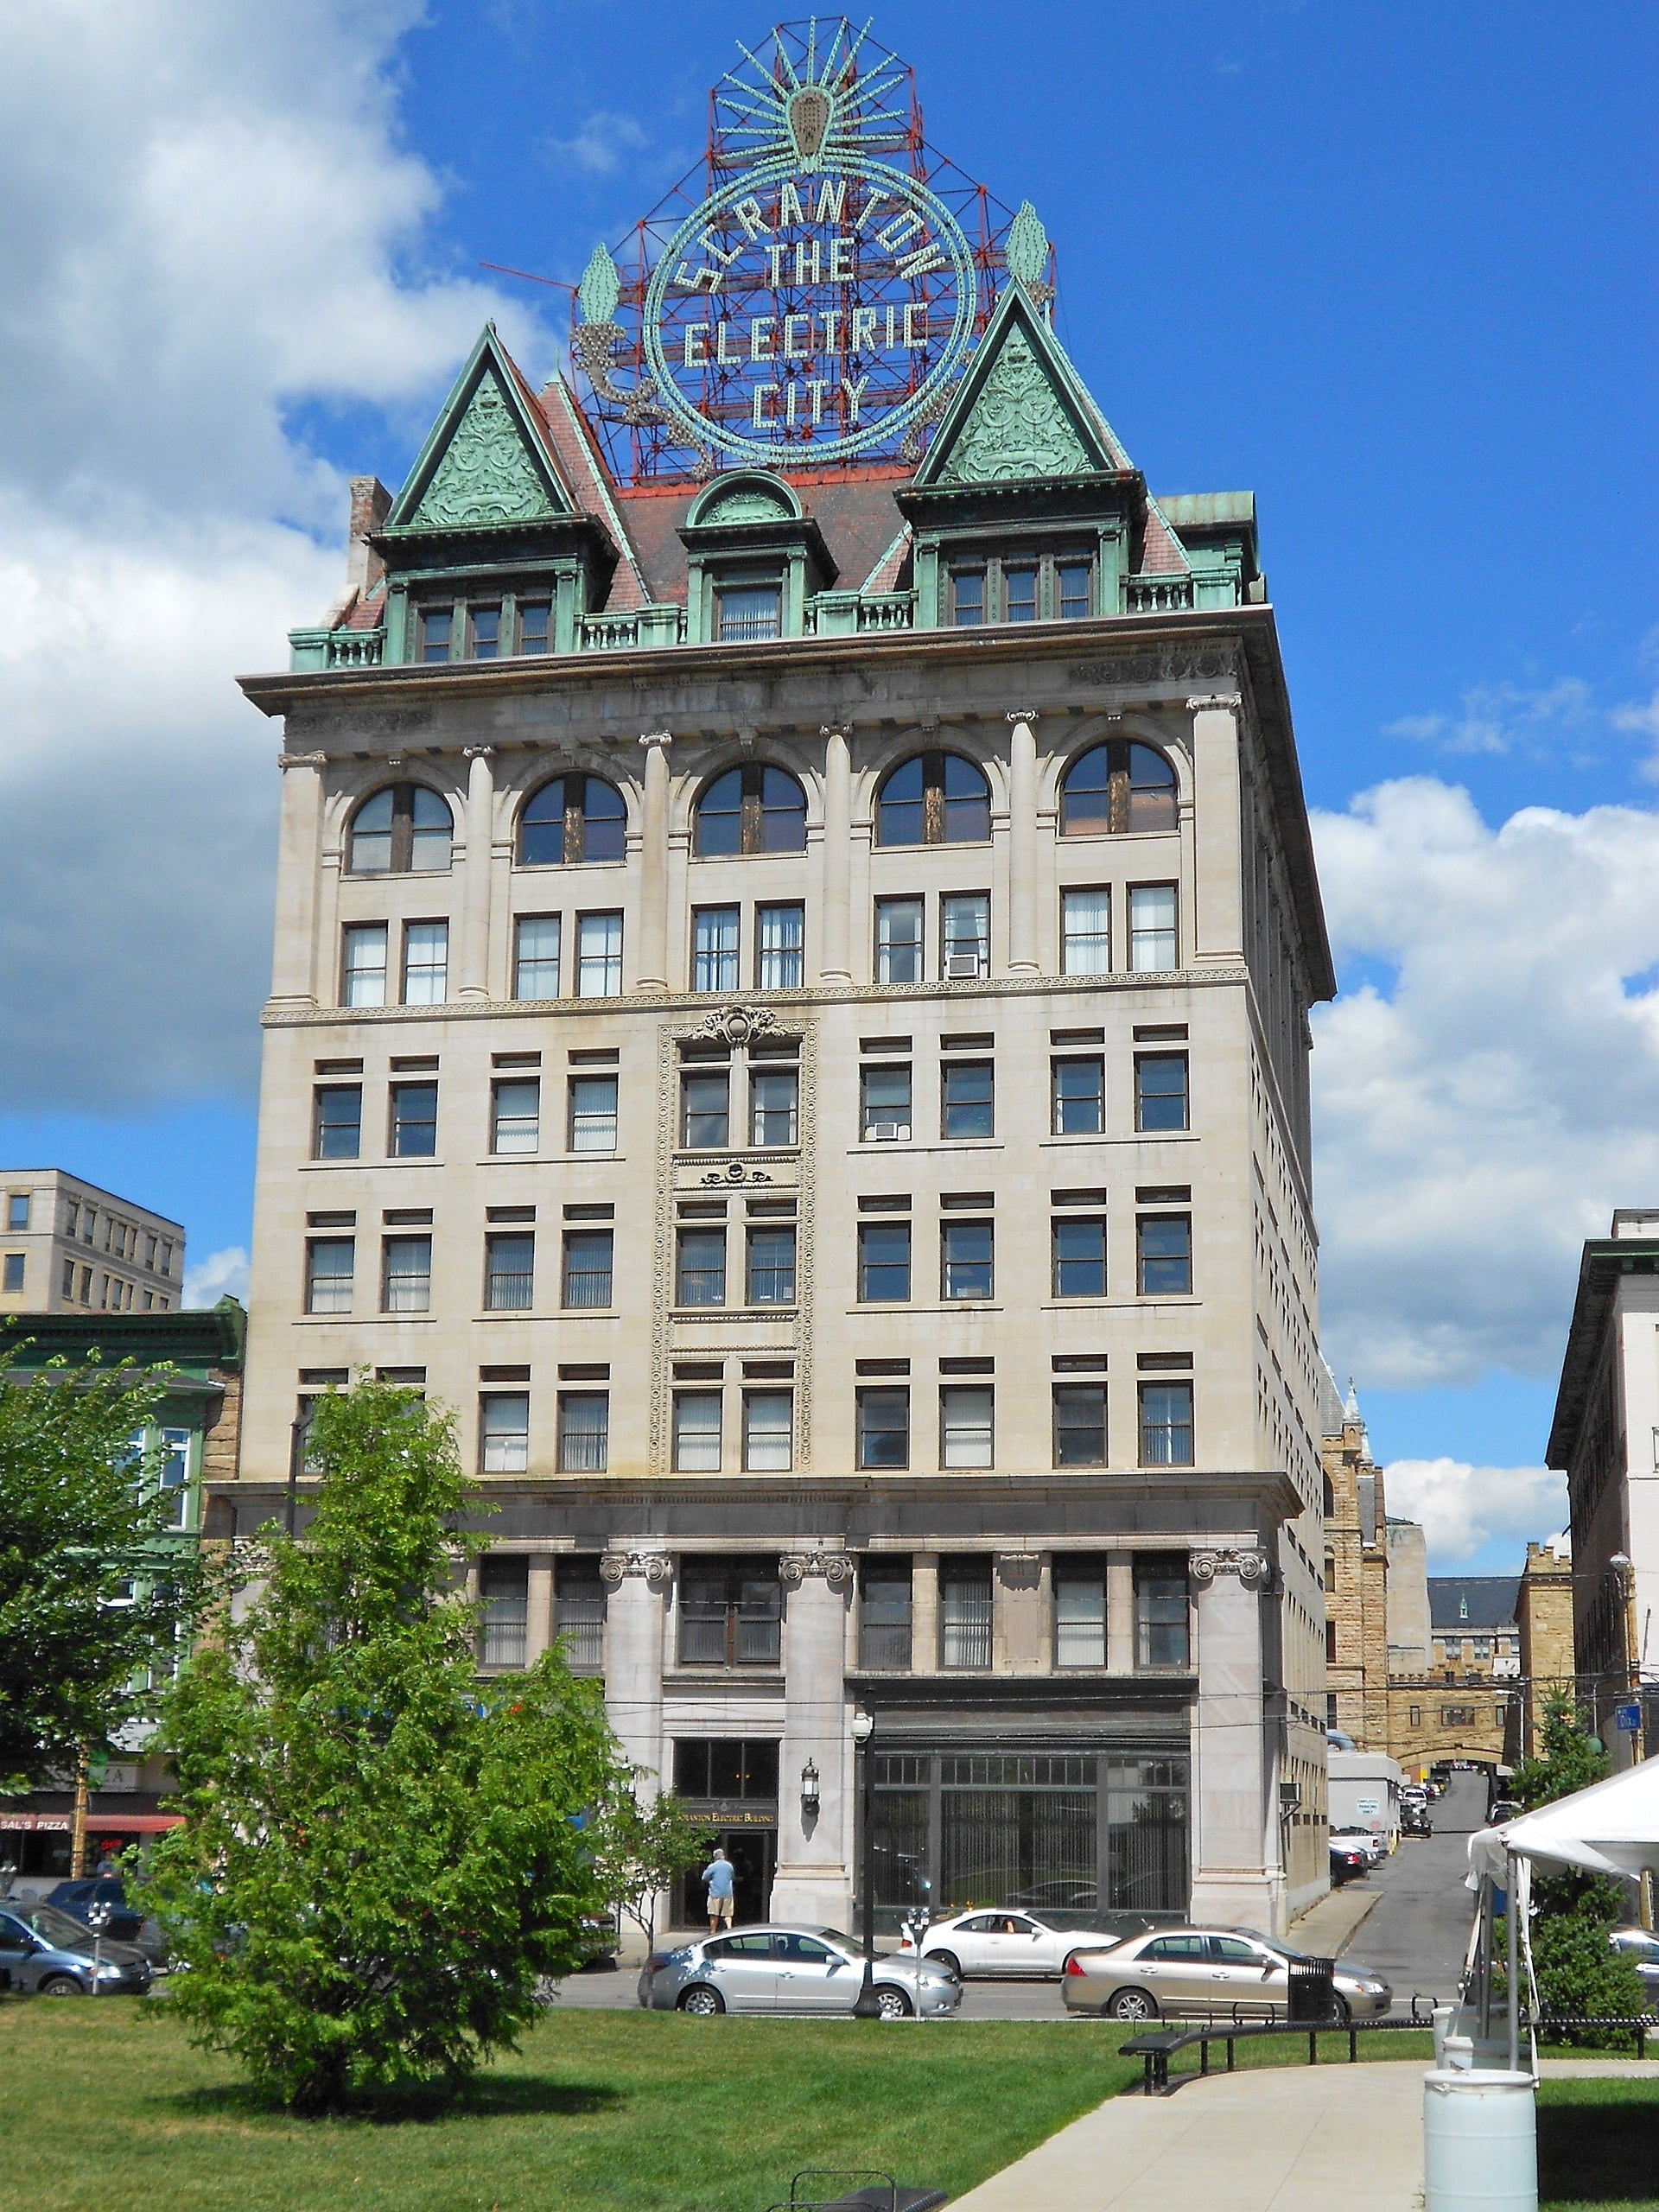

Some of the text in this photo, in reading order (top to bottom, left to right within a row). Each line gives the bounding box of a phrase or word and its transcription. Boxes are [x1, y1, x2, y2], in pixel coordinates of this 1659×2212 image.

[674, 179, 946, 293] SCRANTON
[765, 237, 855, 288] THE
[684, 302, 928, 367] ELECTRIC
[753, 376, 869, 429] CITY
[0, 1821, 68, 1830] SAL'S PIZZA
